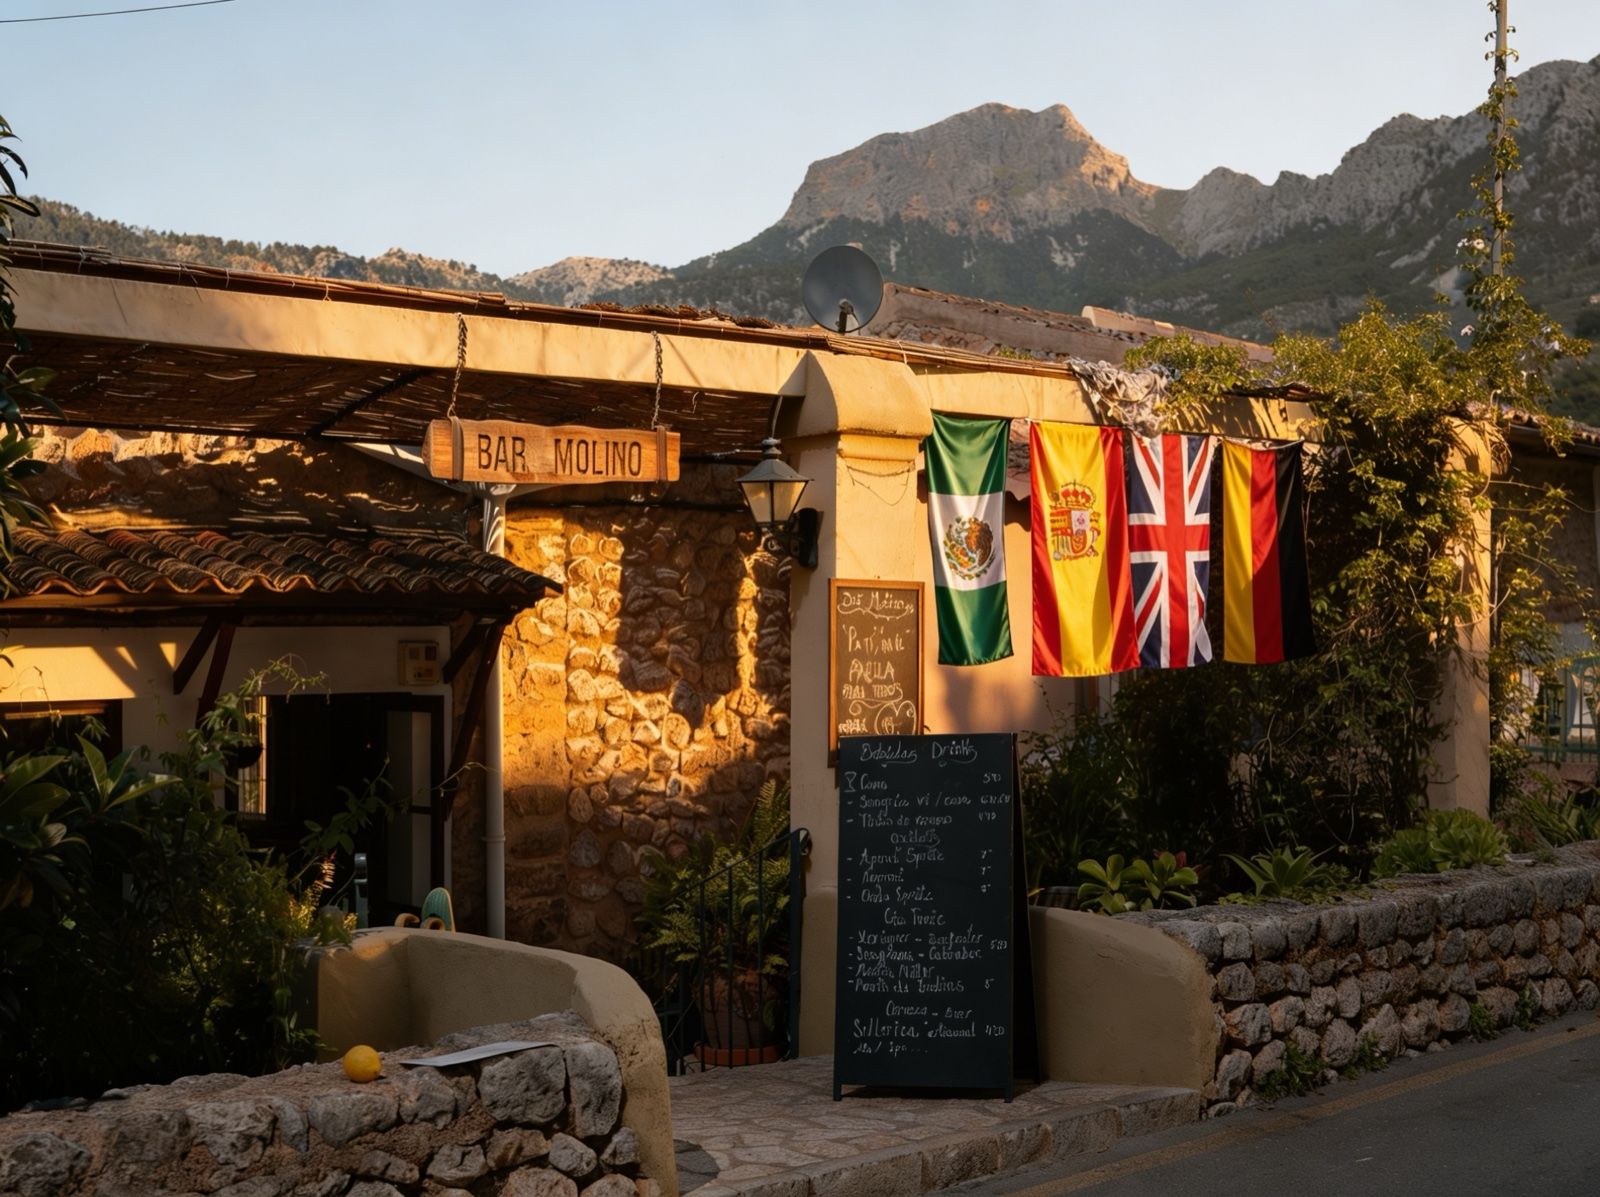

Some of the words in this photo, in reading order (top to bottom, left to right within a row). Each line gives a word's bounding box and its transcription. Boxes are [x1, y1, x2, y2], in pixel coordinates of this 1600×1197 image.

[477, 433, 526, 473] BAR
[554, 438, 642, 476] MOLINO
[931, 738, 977, 762] Drinks
